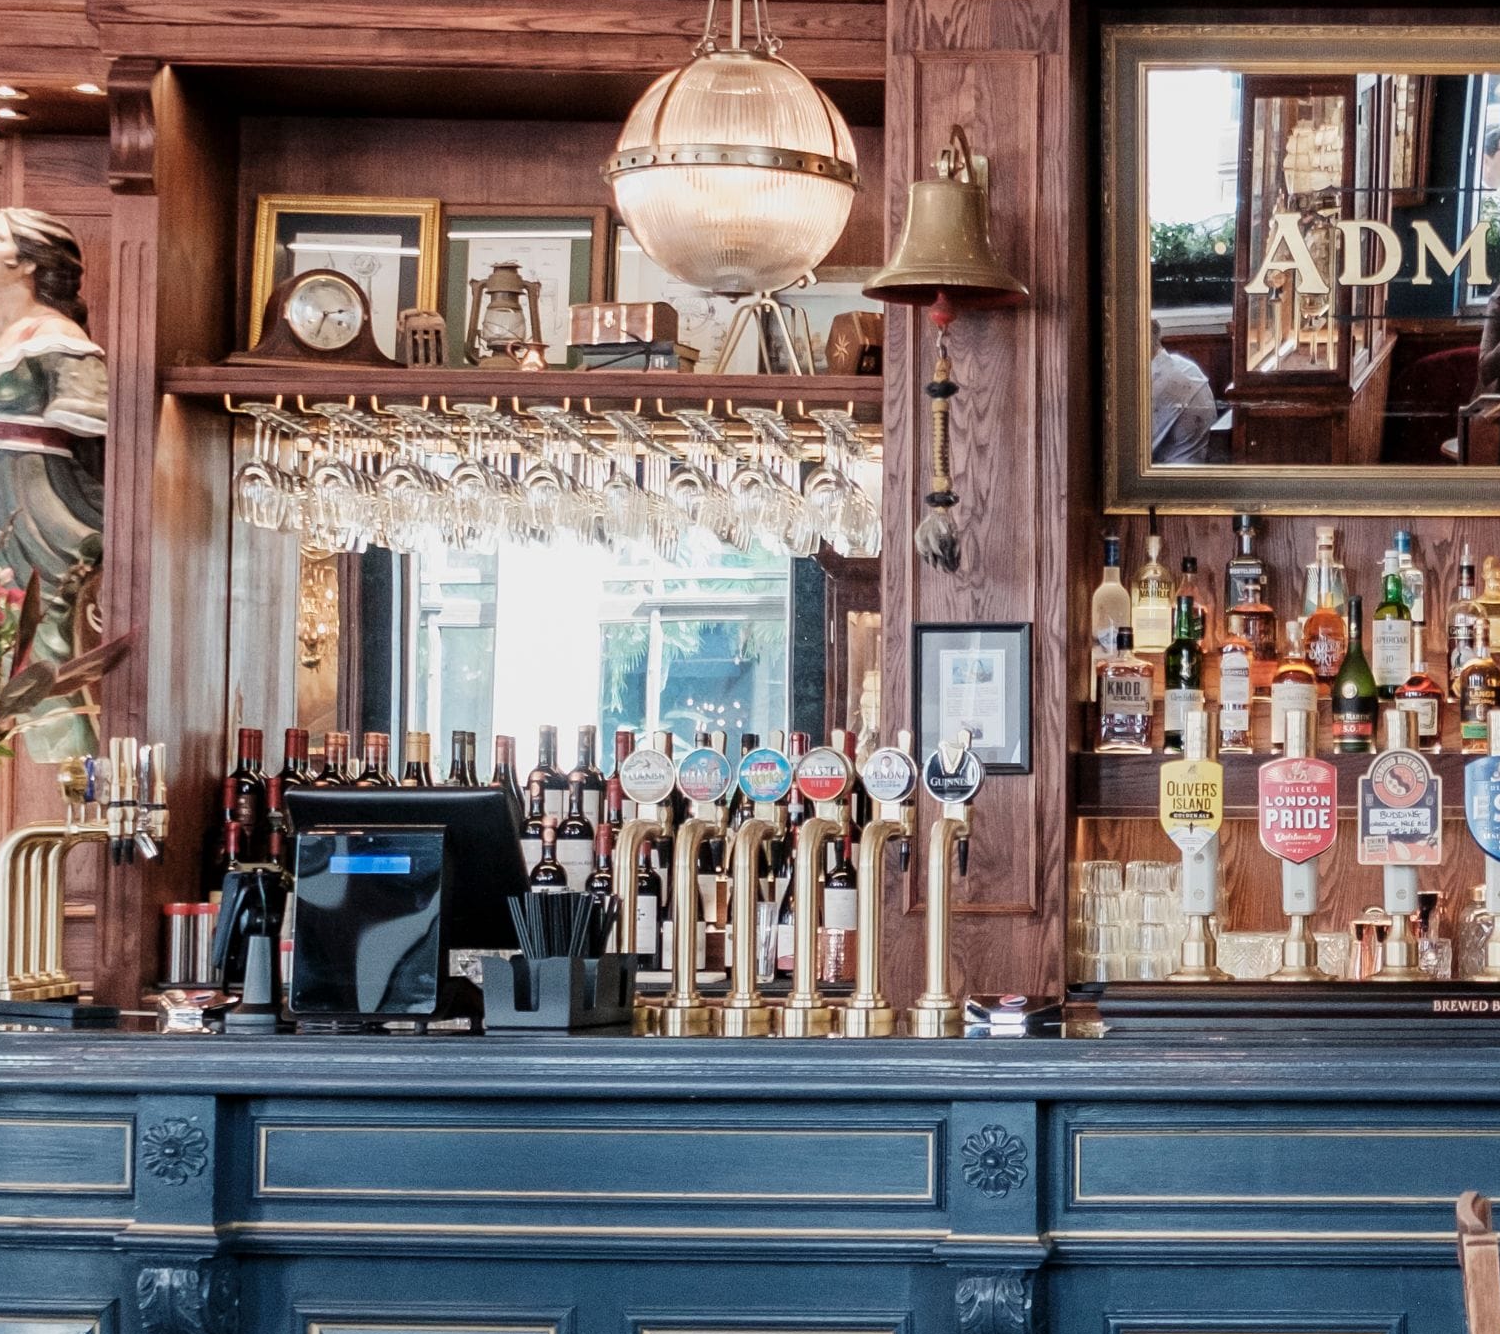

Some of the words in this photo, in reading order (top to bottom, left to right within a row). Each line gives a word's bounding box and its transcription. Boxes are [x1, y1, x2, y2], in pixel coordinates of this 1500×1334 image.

[1107, 681, 1141, 696] KNOB
[1172, 797, 1212, 811] ISLAND
[1265, 795, 1331, 807] LONDON
[1265, 808, 1331, 830] PRIDE
[1433, 999, 1489, 1012] BREWED
